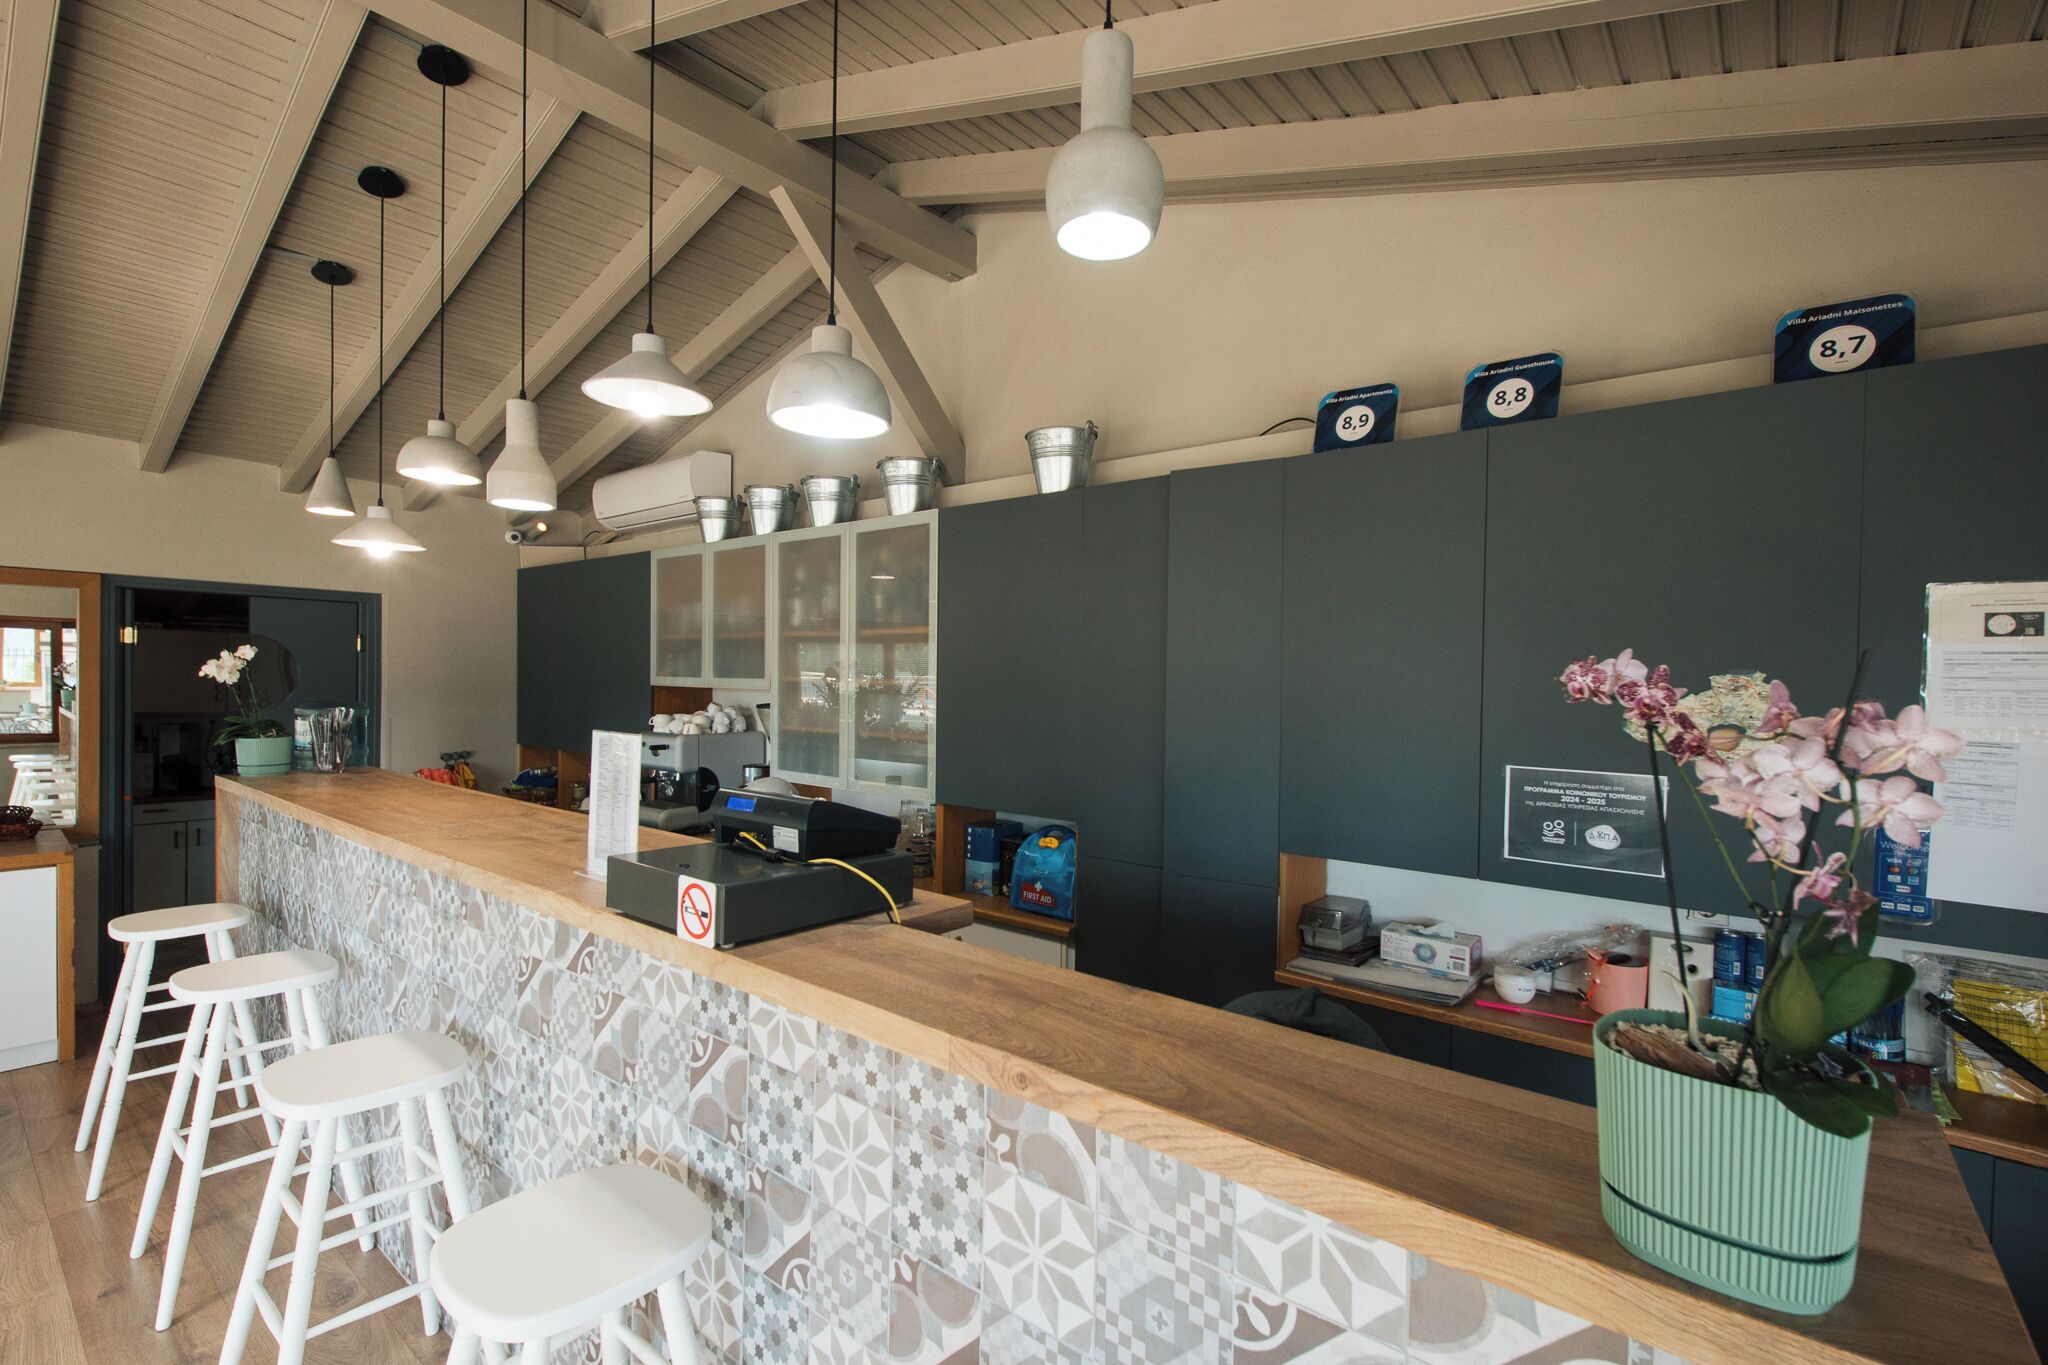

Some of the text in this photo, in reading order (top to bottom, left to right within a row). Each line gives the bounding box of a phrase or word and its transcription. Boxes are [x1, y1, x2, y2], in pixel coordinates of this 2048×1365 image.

[1787, 301, 1903, 326] Villa Ariadni Maisonettes
[1820, 334, 1867, 359] 8,7
[1474, 359, 1556, 378] Villa Ariadni Guesthouse
[1338, 394, 1359, 402] Ariadni
[1358, 389, 1393, 399] Apartments
[1494, 387, 1527, 407] 8,8
[1342, 413, 1369, 431] 8,9
[1523, 785, 1565, 795] ΠΡΟΓΡΑΜΜΑ
[1608, 792, 1647, 802] ΤΟΥΡΙΣΜΟΥ
[1560, 795, 1580, 803] 2024
[1586, 797, 1606, 806] 2025
[1023, 891, 1052, 904] FIRST AID
